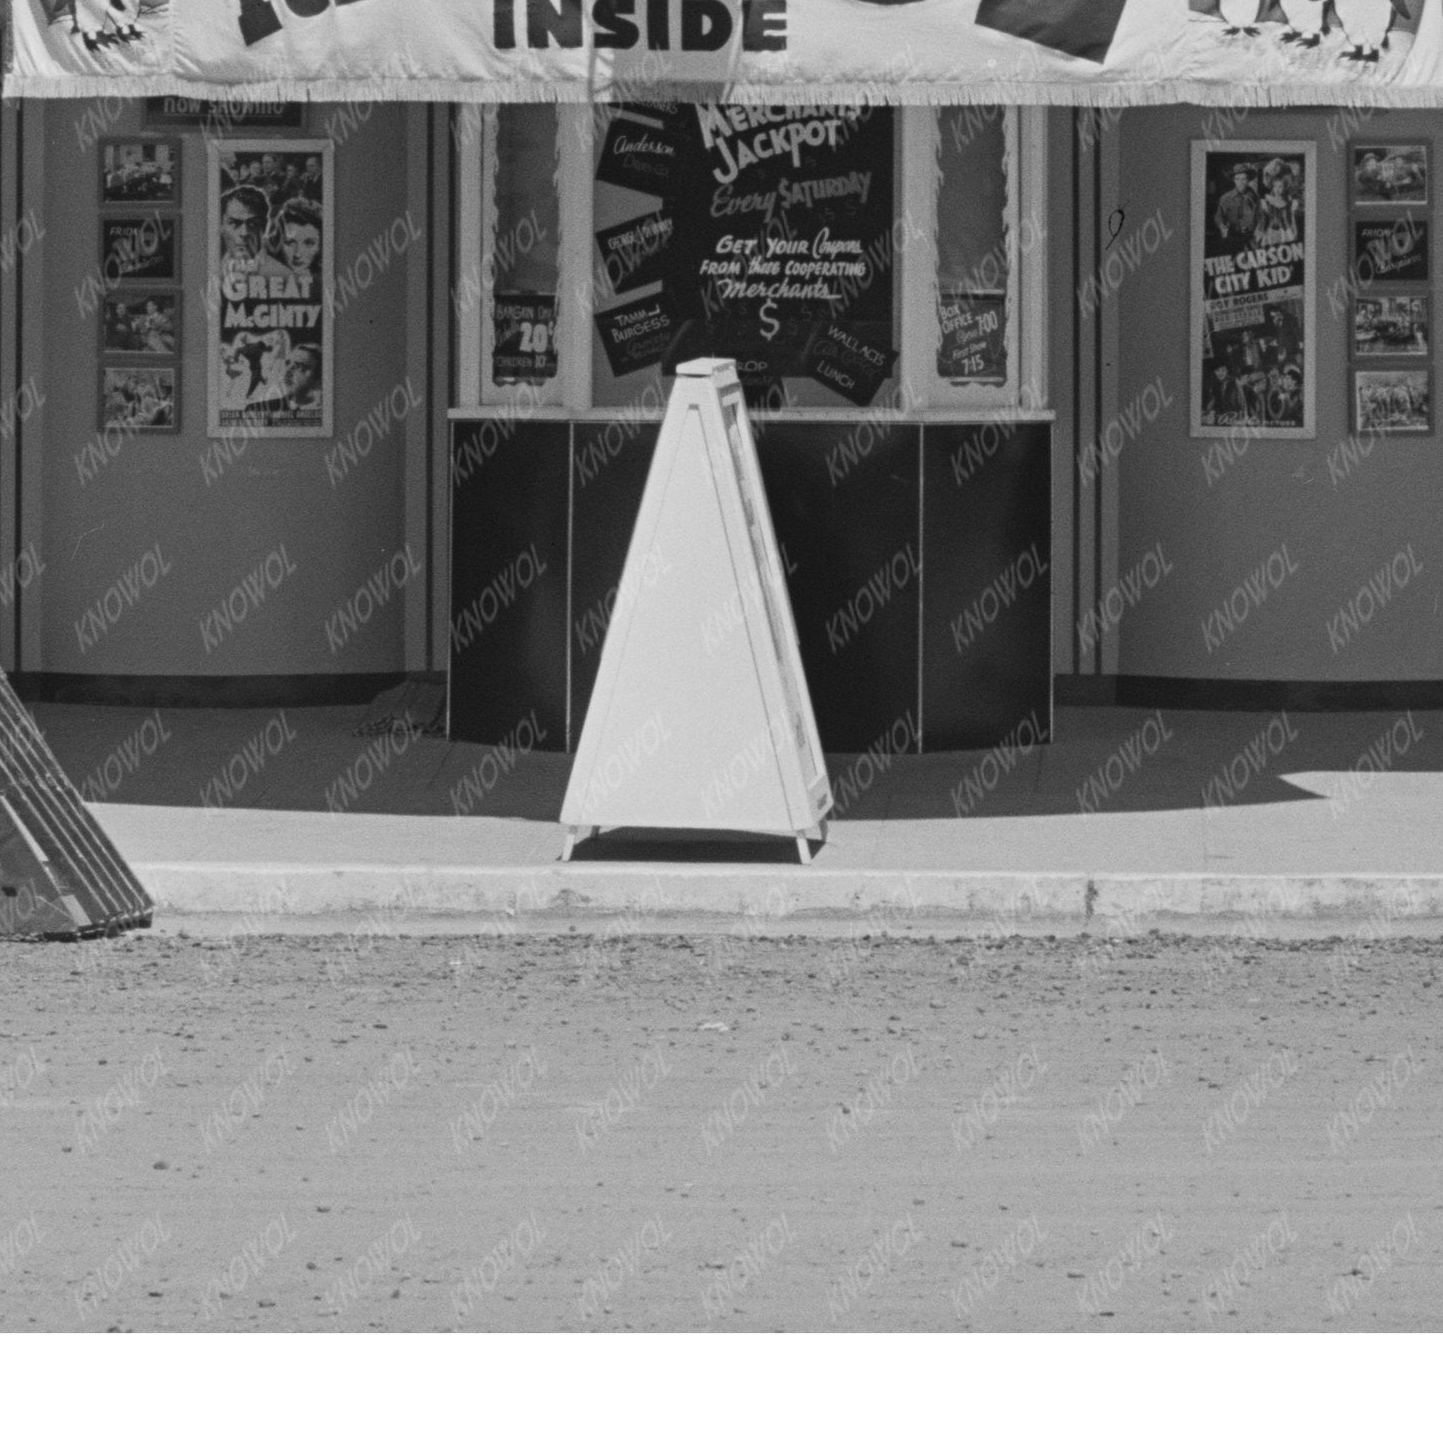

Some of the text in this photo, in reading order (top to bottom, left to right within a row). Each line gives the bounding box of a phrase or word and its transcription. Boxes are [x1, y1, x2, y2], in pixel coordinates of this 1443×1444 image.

[712, 119, 842, 184] JACKPOT
[710, 184, 778, 224] Every
[716, 234, 758, 254] GET
[765, 237, 810, 258] YOUR
[1205, 242, 1305, 277] THE CARSON
[699, 259, 741, 275] FROM
[784, 259, 866, 280] COOPERATING
[1215, 265, 1292, 295] CITY KID
[222, 272, 314, 302] GREAT
[716, 275, 842, 300] Merchants
[817, 359, 855, 389] LUNCH
